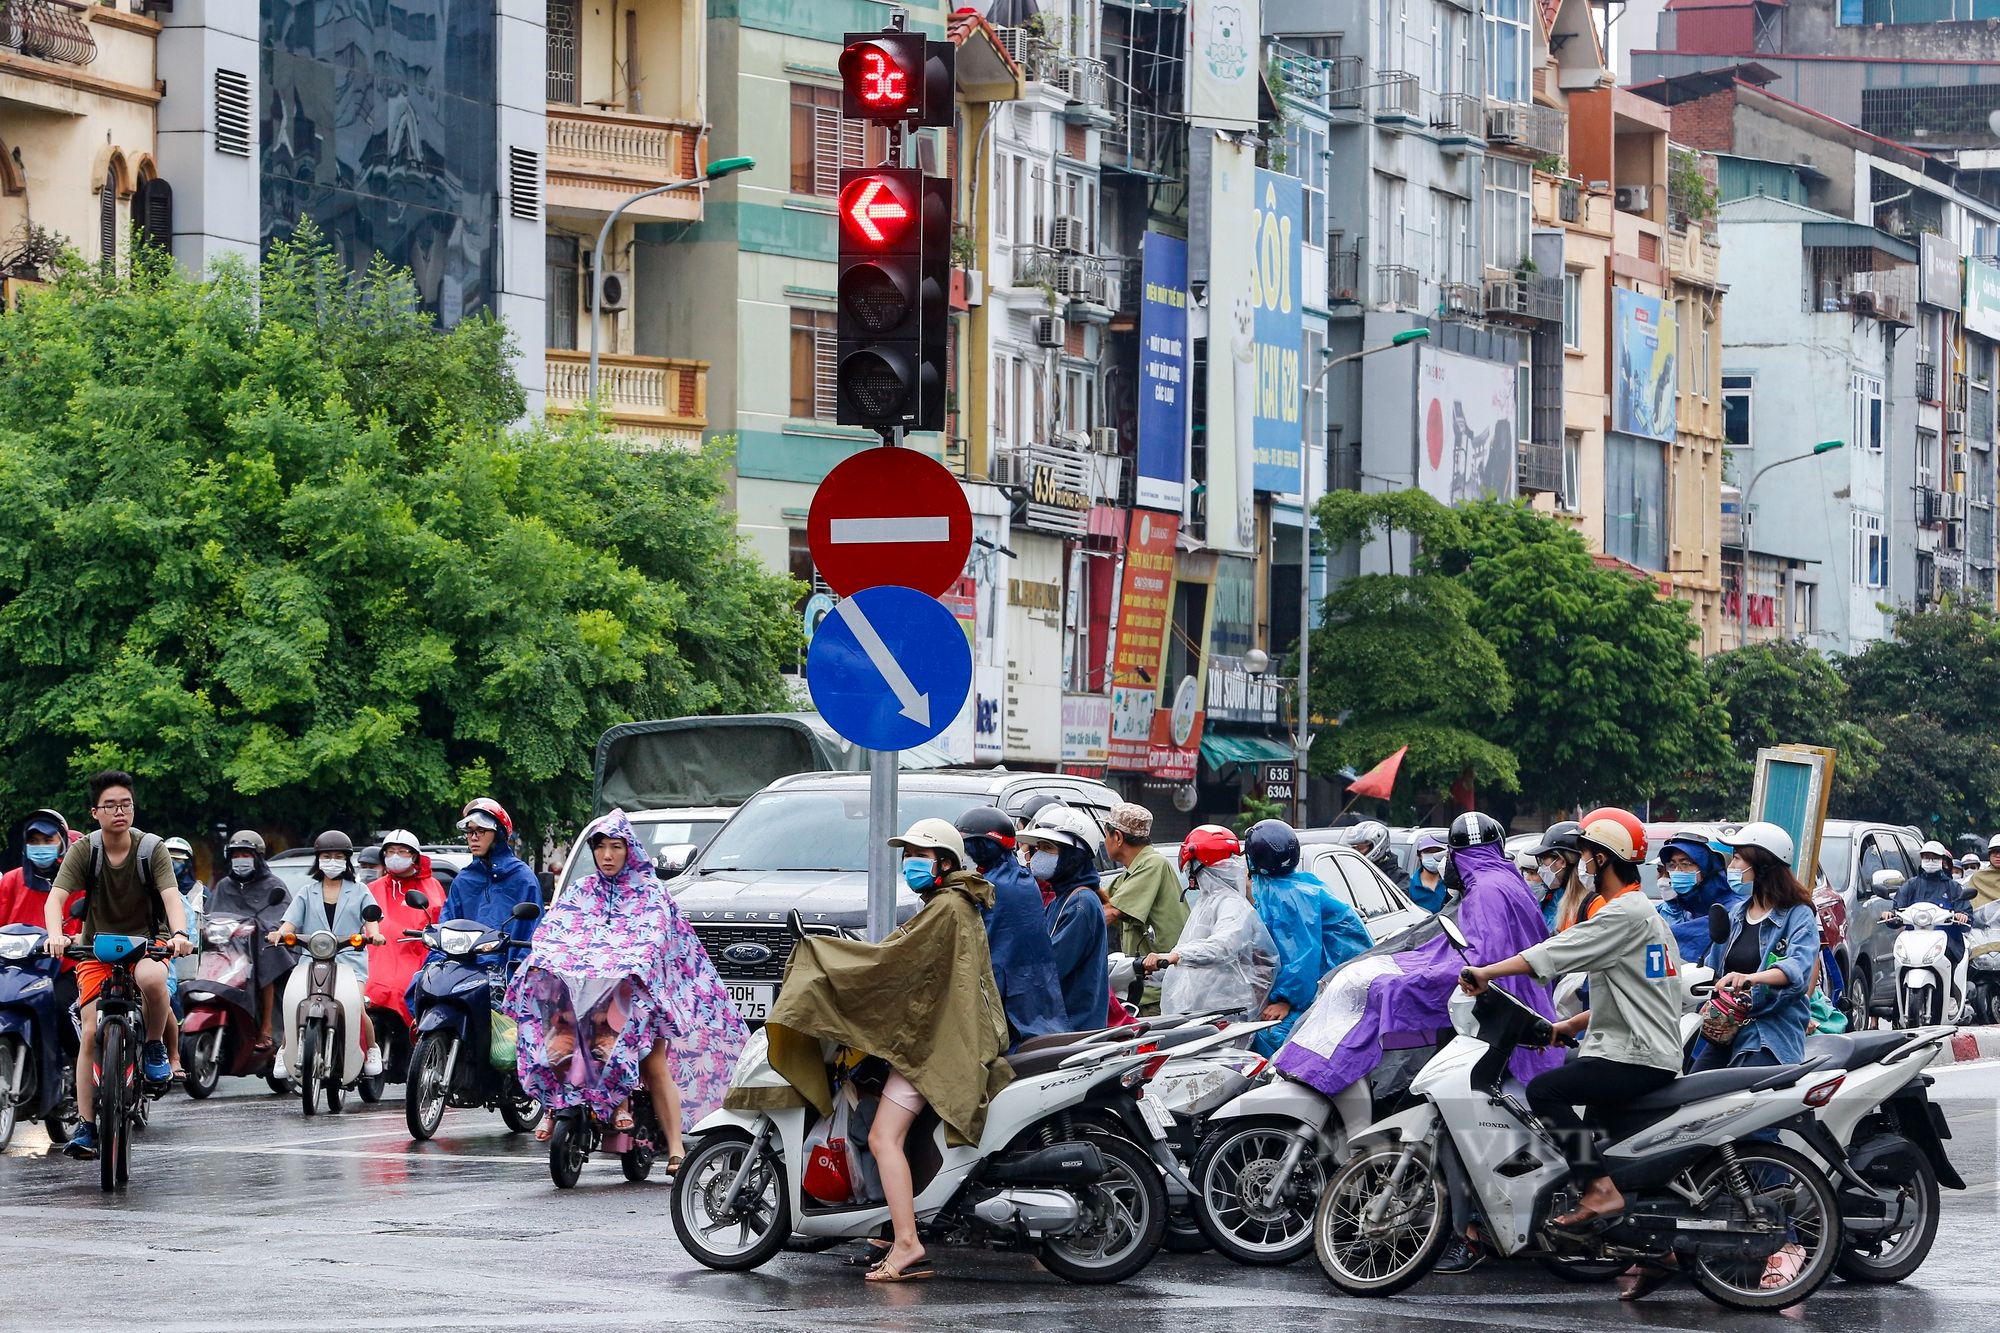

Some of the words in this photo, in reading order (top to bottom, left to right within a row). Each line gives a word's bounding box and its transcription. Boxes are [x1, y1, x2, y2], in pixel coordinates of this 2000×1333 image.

[1281, 348, 1299, 424] 628
[1034, 464, 1056, 505] 636
[1208, 660, 1222, 708] XÔI
[1270, 768, 1289, 781] 636
[1267, 785, 1293, 799] 630A
[682, 910, 827, 922] EVERET
[733, 946, 761, 960] Ford
[739, 1003, 766, 1018] 7.75
[1039, 1068, 1097, 1092] VISION
[1478, 1121, 1511, 1130] HONDA
